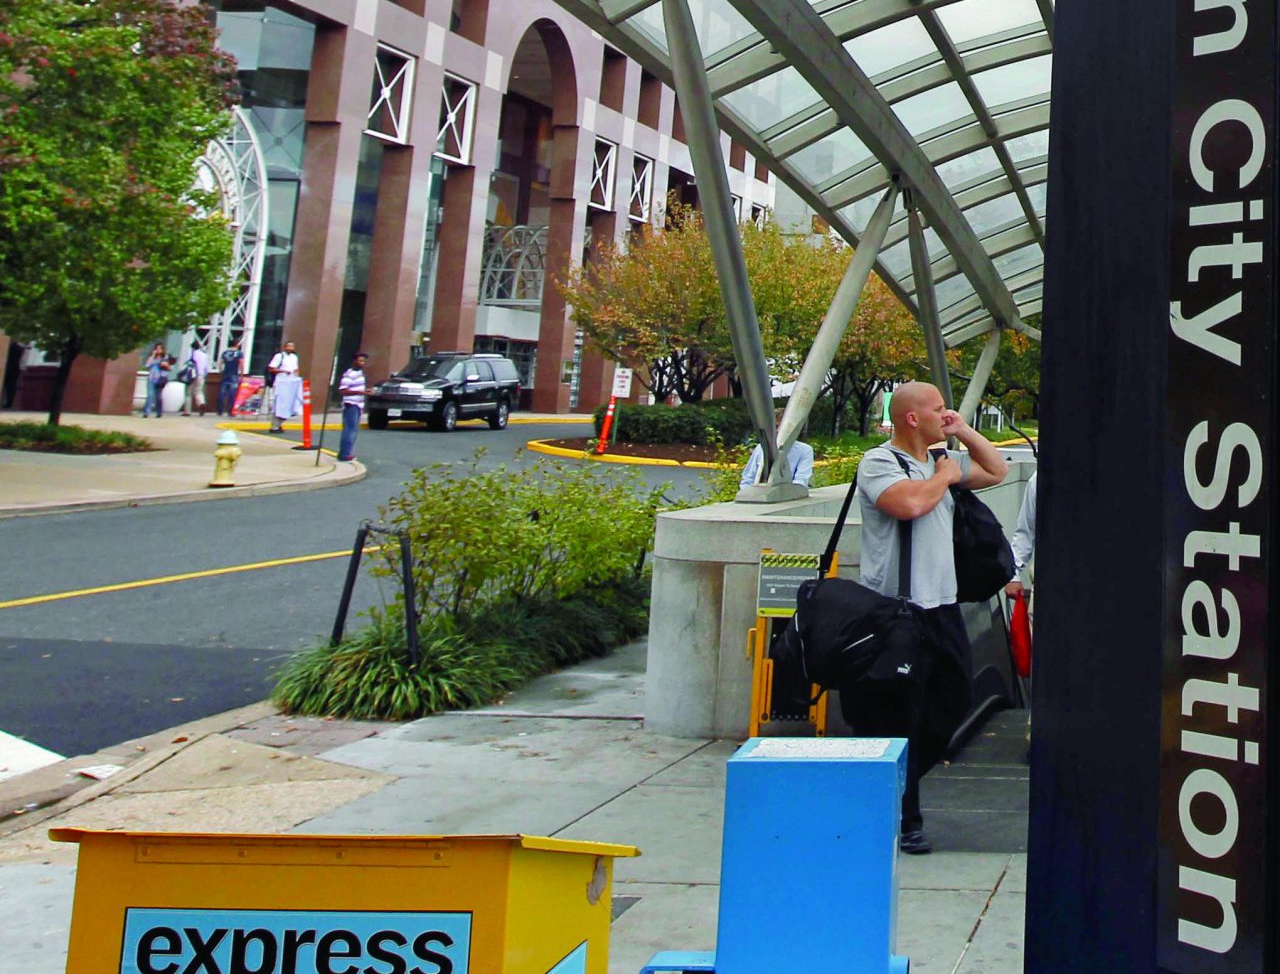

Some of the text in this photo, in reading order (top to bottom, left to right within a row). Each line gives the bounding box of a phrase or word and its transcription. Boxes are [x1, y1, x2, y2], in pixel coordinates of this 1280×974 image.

[1169, 99, 1266, 367] City
[1178, 420, 1263, 954] Station
[135, 924, 457, 974] express
